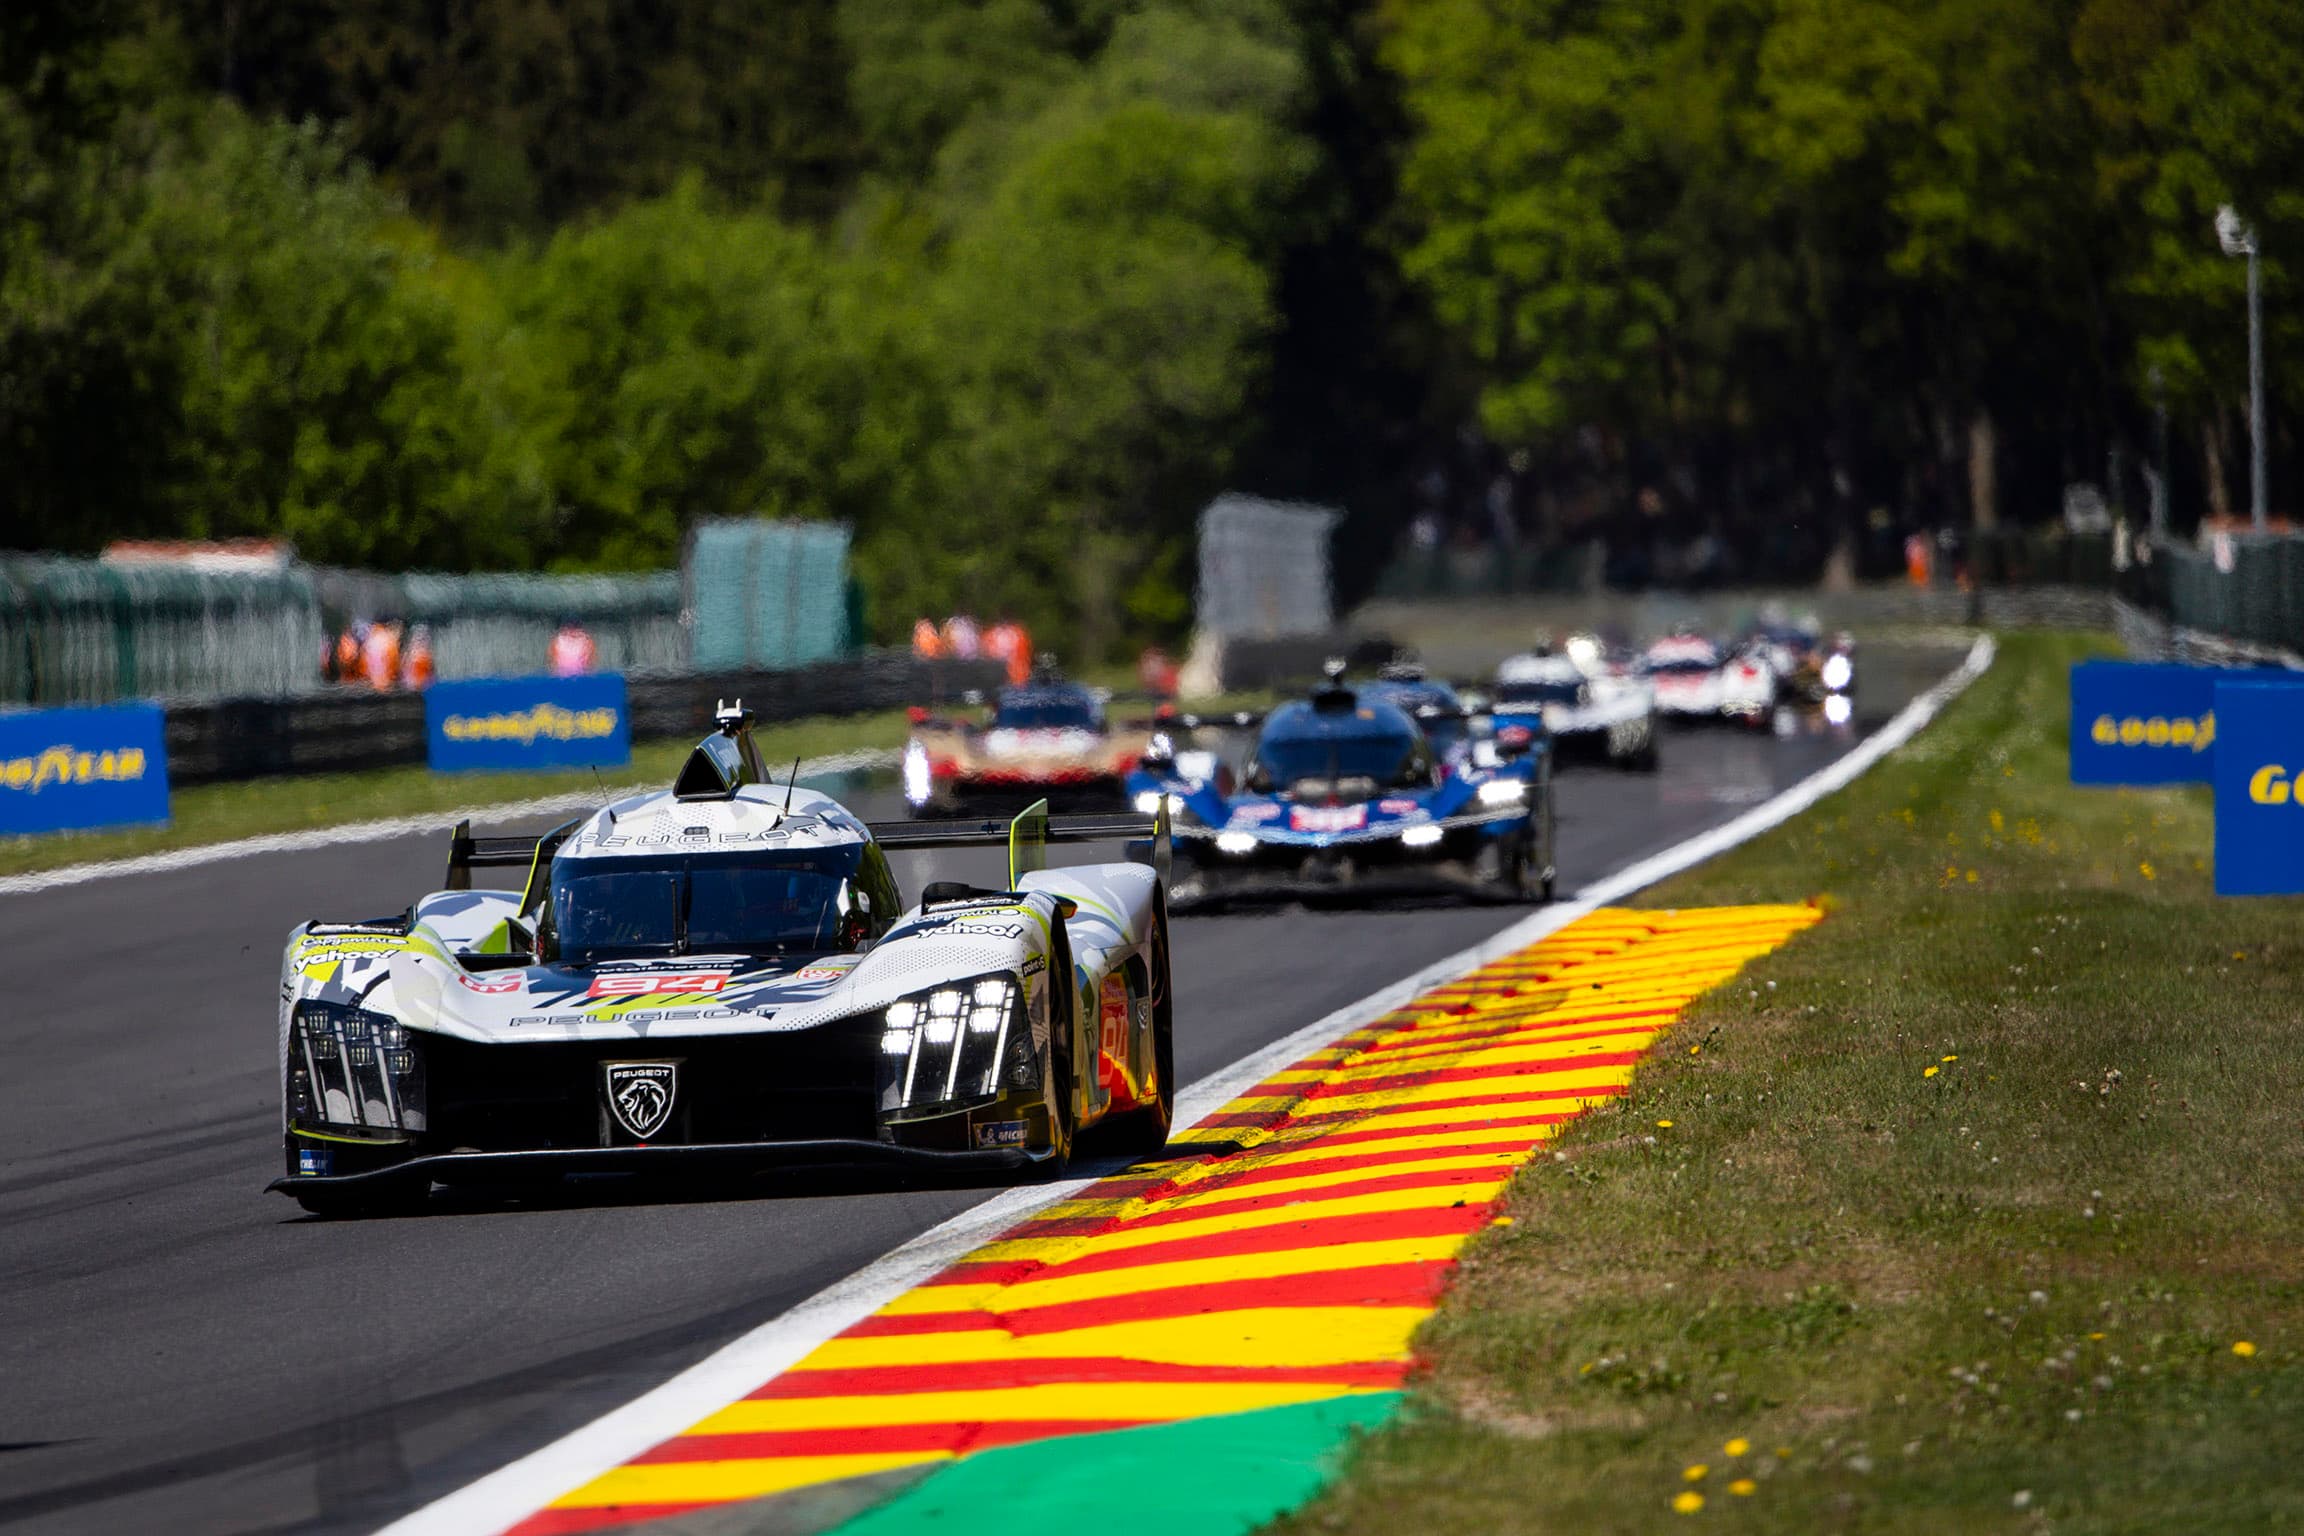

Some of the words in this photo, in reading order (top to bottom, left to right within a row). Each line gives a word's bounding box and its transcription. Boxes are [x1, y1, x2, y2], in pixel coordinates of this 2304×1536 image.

[578, 823, 818, 847] PEUGEOT
[917, 922, 1023, 939] yahoo!
[294, 949, 399, 974] yahoo!
[598, 976, 716, 996] 94
[509, 1007, 782, 1027] PEUGEOT
[613, 1069, 670, 1080] PEUGEOT
